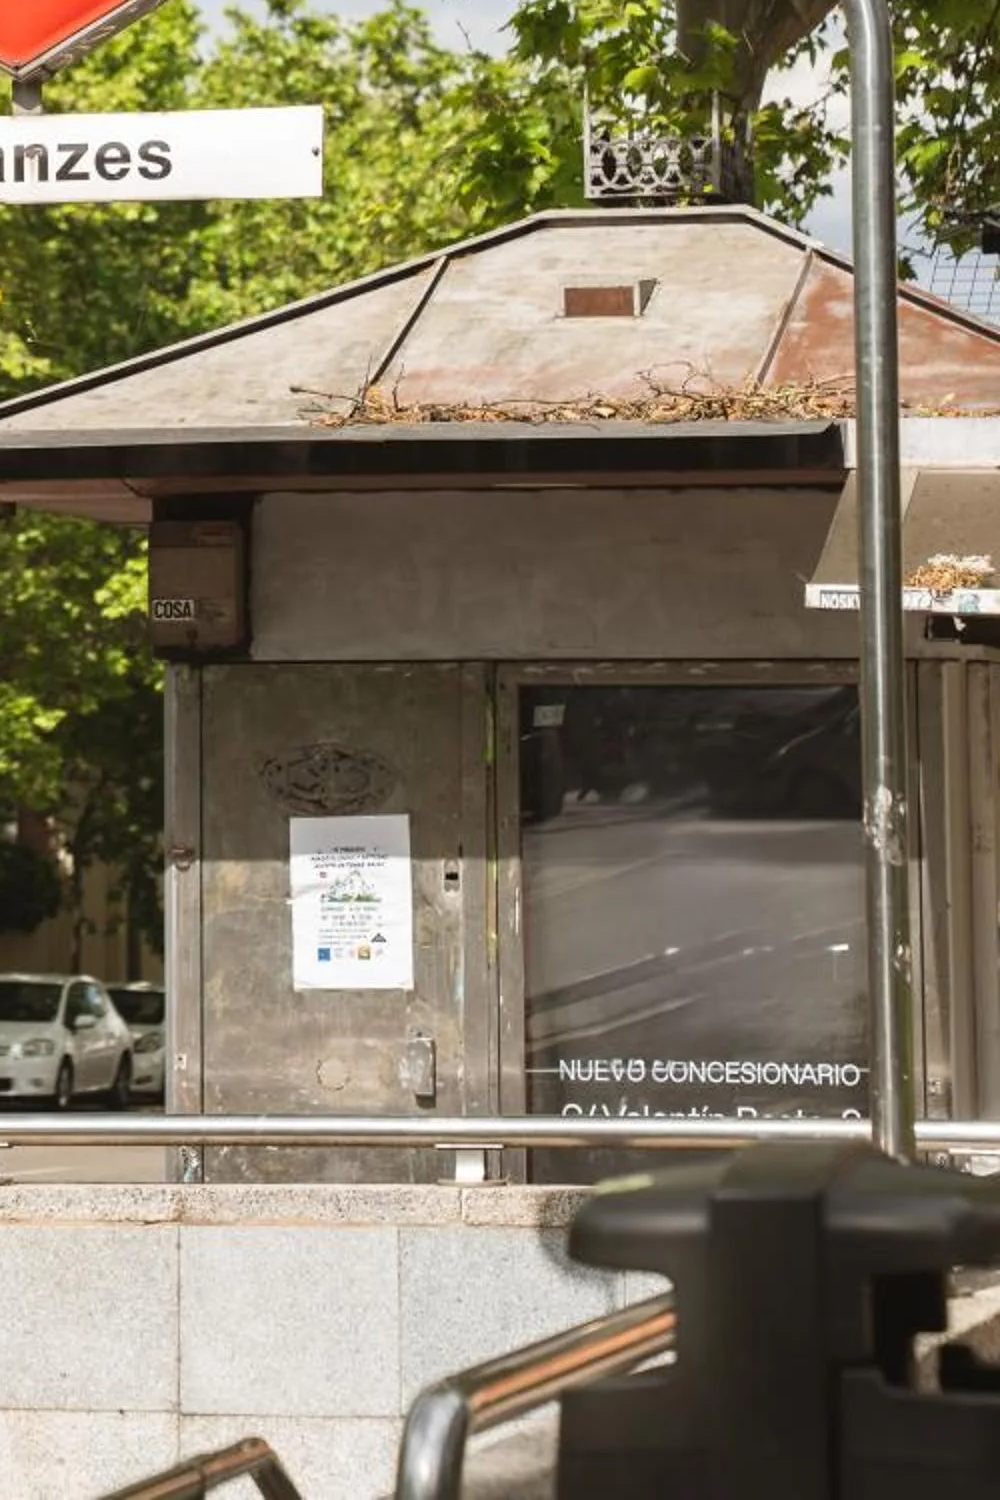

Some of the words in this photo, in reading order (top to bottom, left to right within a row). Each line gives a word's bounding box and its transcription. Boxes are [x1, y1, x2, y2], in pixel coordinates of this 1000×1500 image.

[154, 601, 191, 619] COSA
[559, 1059, 646, 1082] NUEVO
[652, 1060, 861, 1087] CONCESIONARIO
